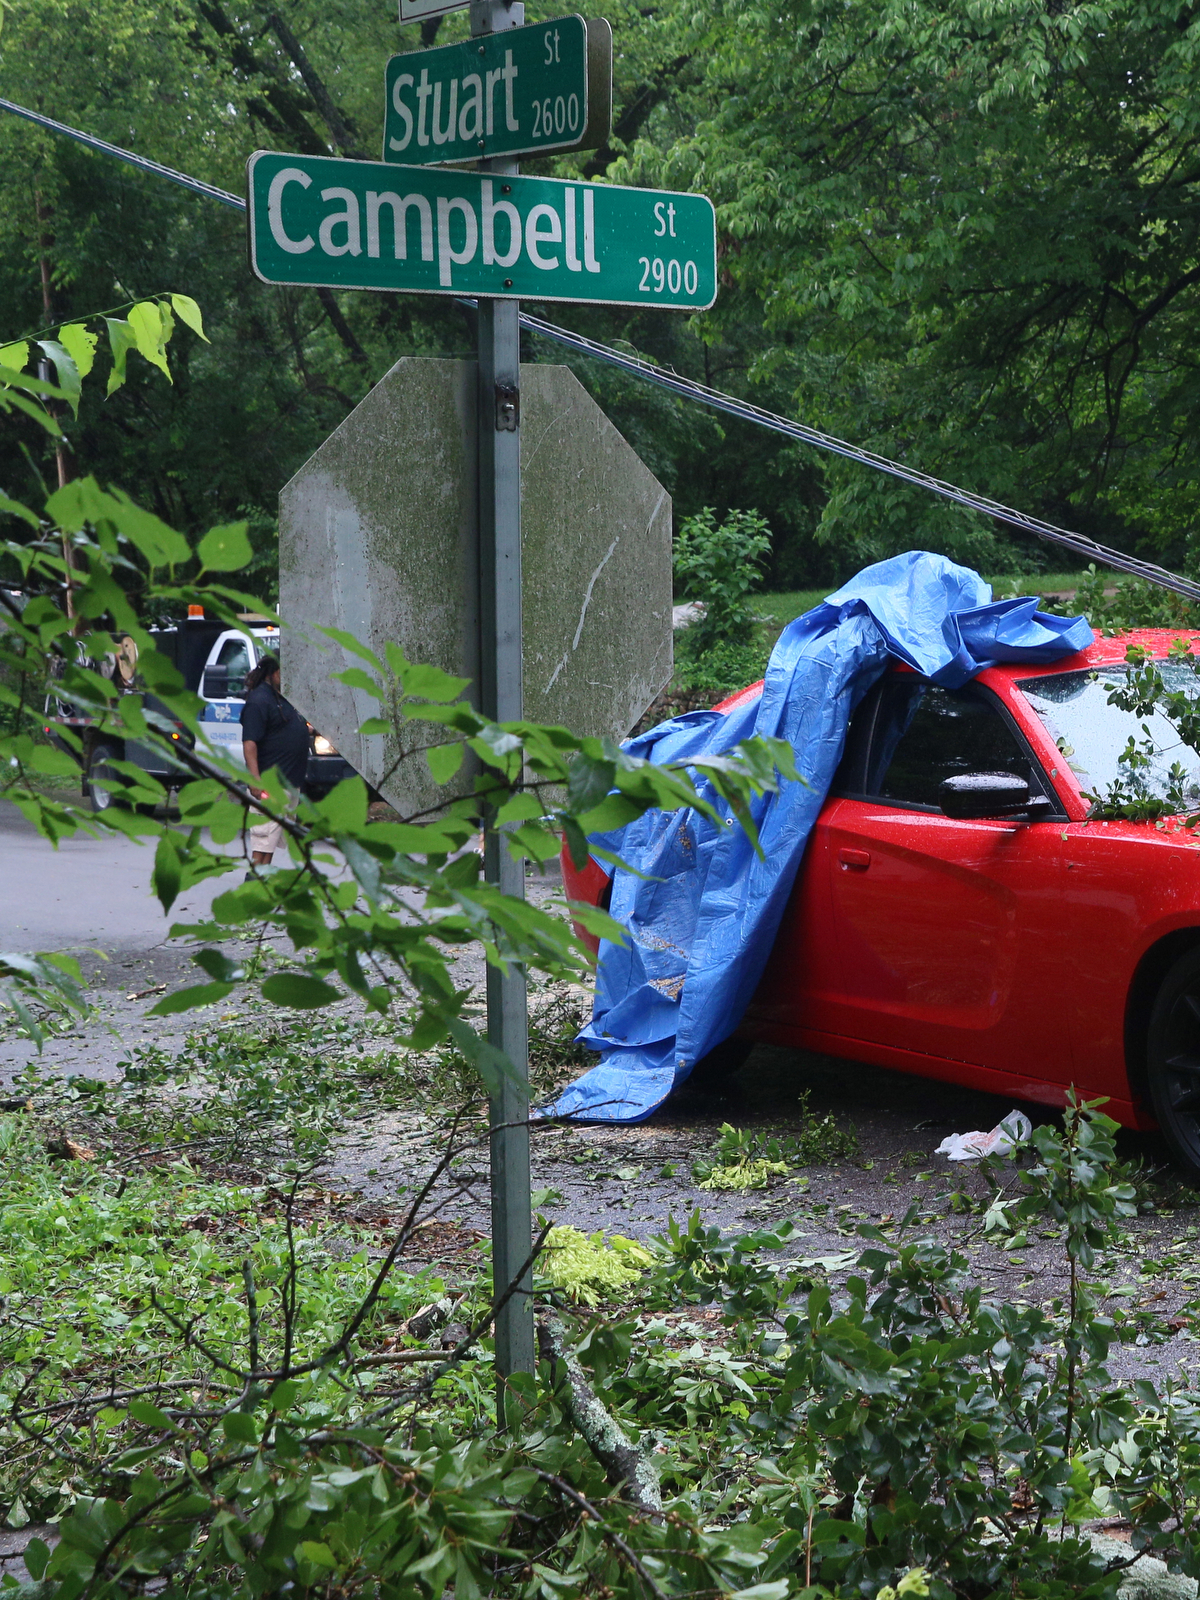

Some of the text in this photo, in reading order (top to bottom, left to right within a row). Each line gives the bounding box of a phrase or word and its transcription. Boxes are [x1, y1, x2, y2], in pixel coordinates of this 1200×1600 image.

[388, 28, 561, 153] Stuart St
[531, 92, 580, 138] 2600
[267, 167, 677, 287] Campbell St
[638, 256, 699, 295] 2900
